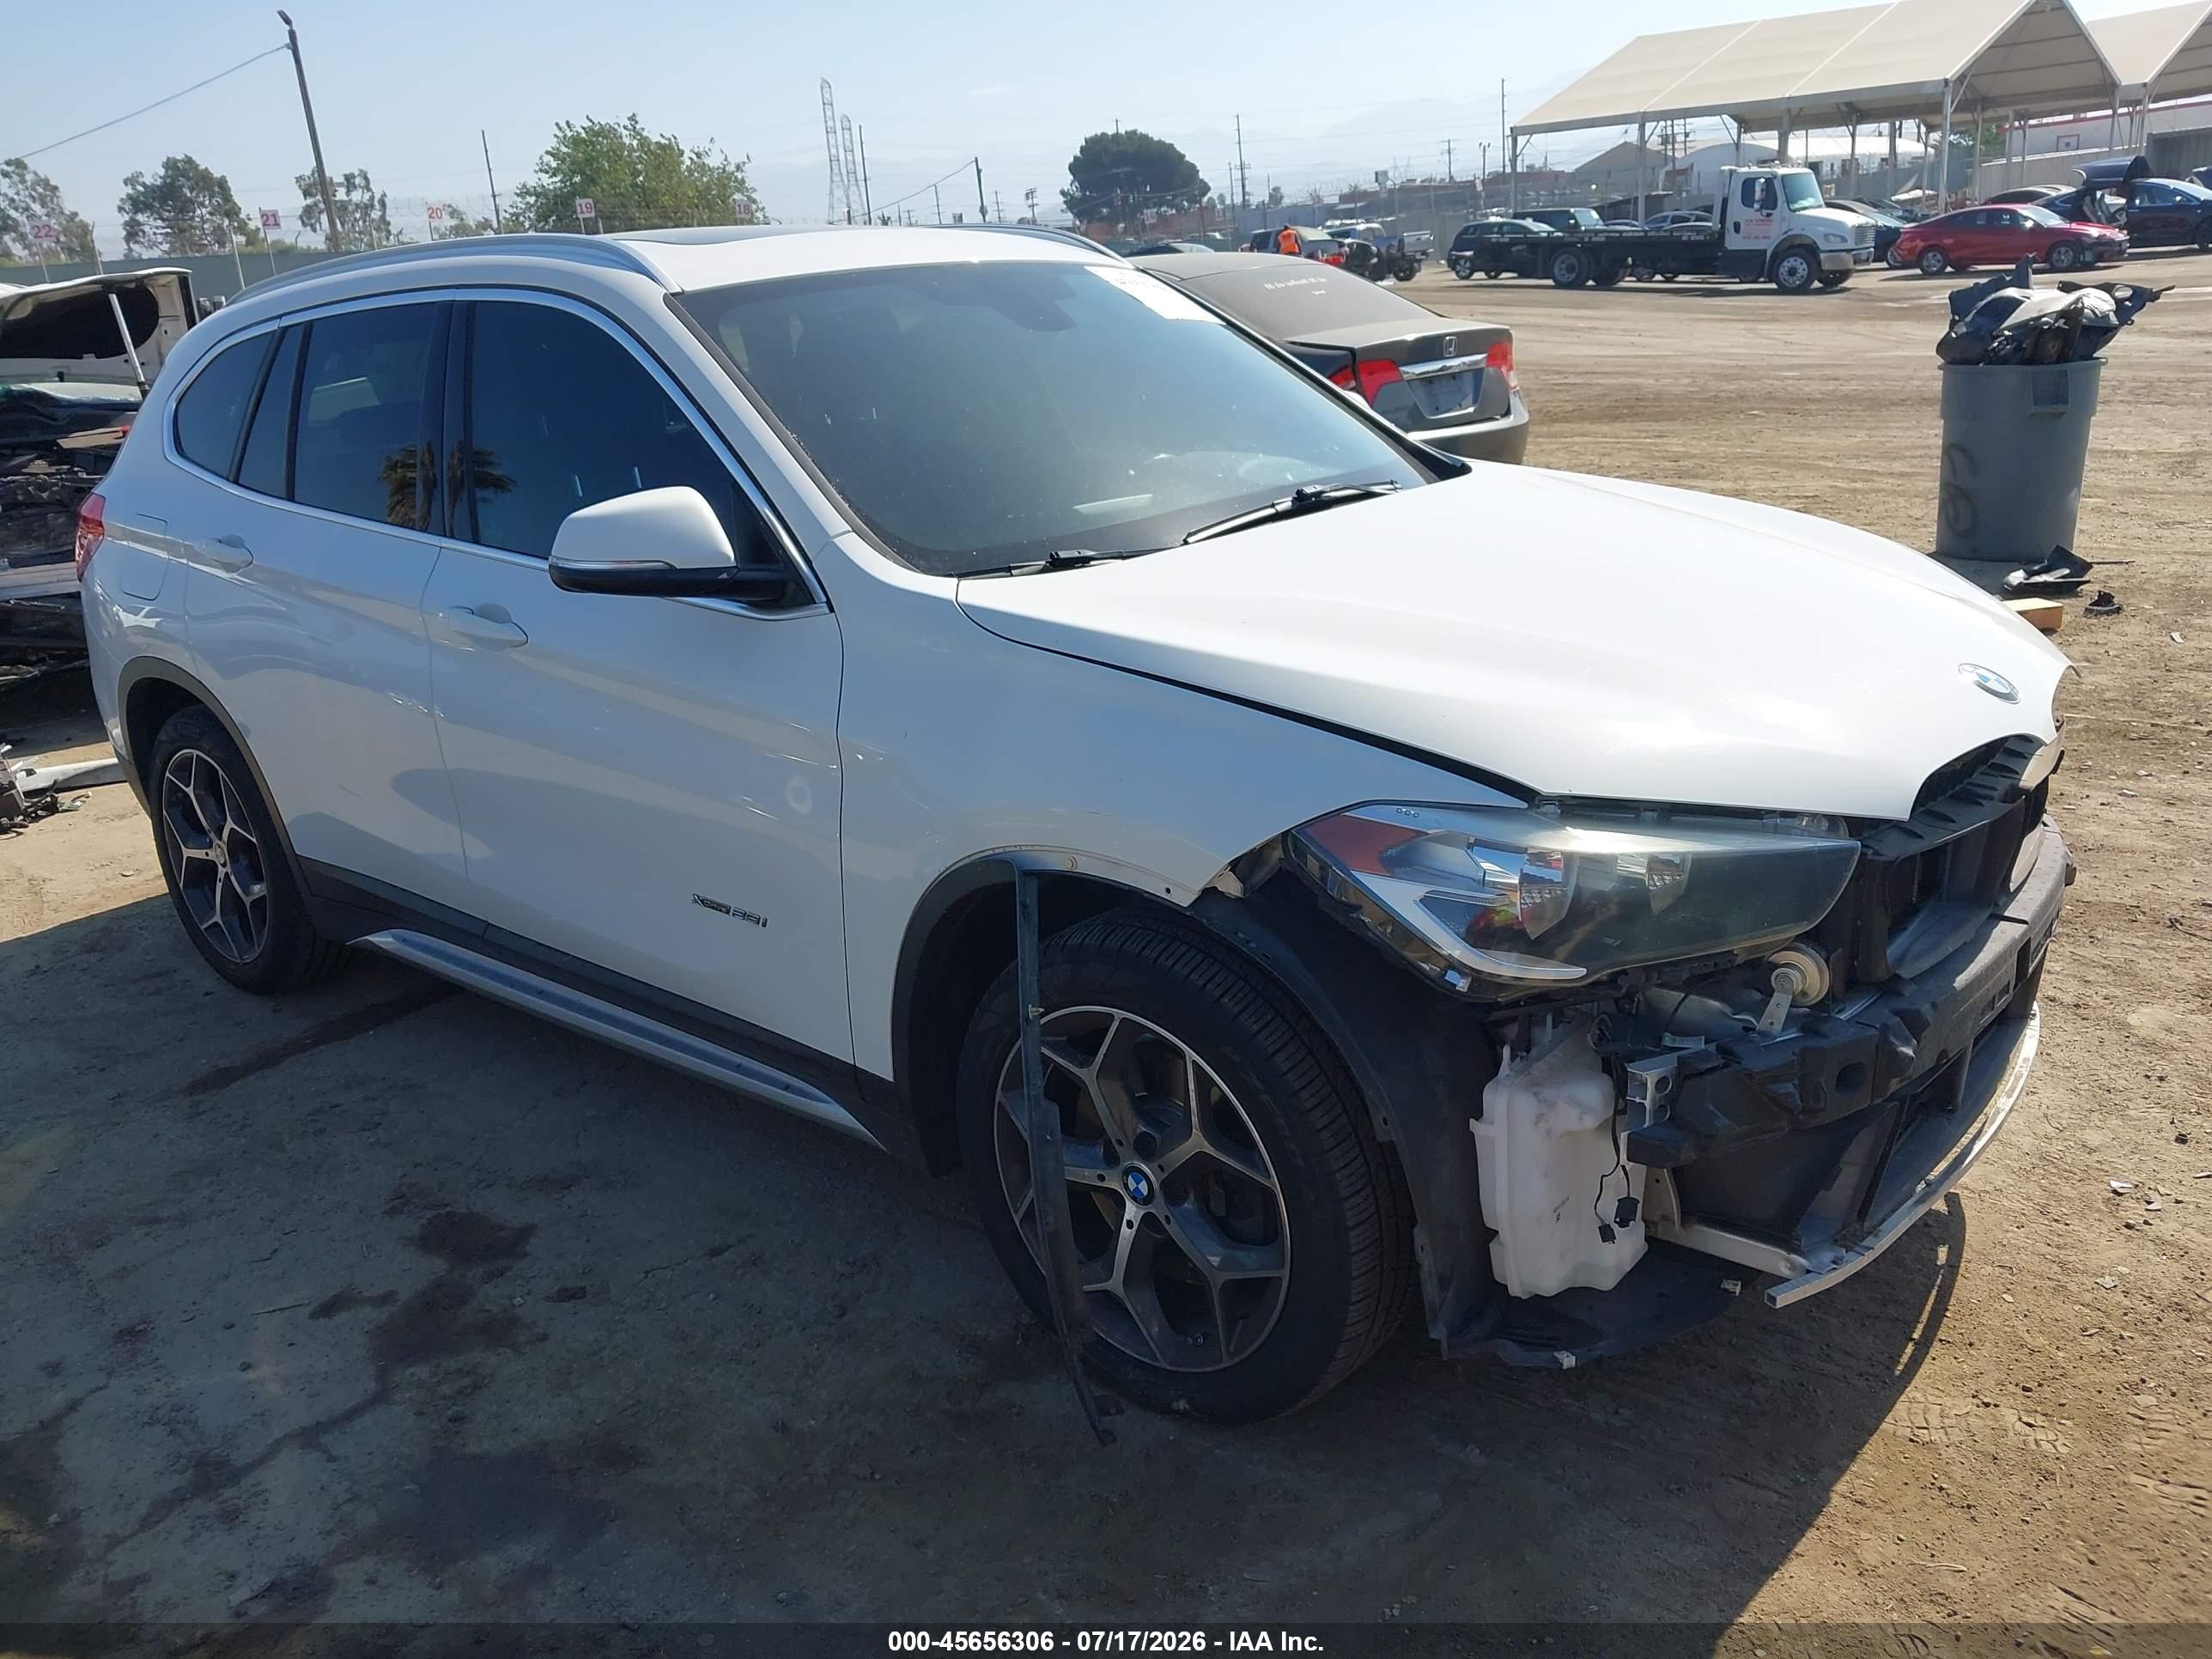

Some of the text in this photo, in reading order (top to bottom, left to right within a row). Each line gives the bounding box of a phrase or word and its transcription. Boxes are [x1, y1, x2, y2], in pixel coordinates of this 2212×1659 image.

[427, 206, 443, 220] 20
[578, 202, 592, 214] 19
[260, 213, 281, 227] 21
[31, 224, 54, 239] 22
